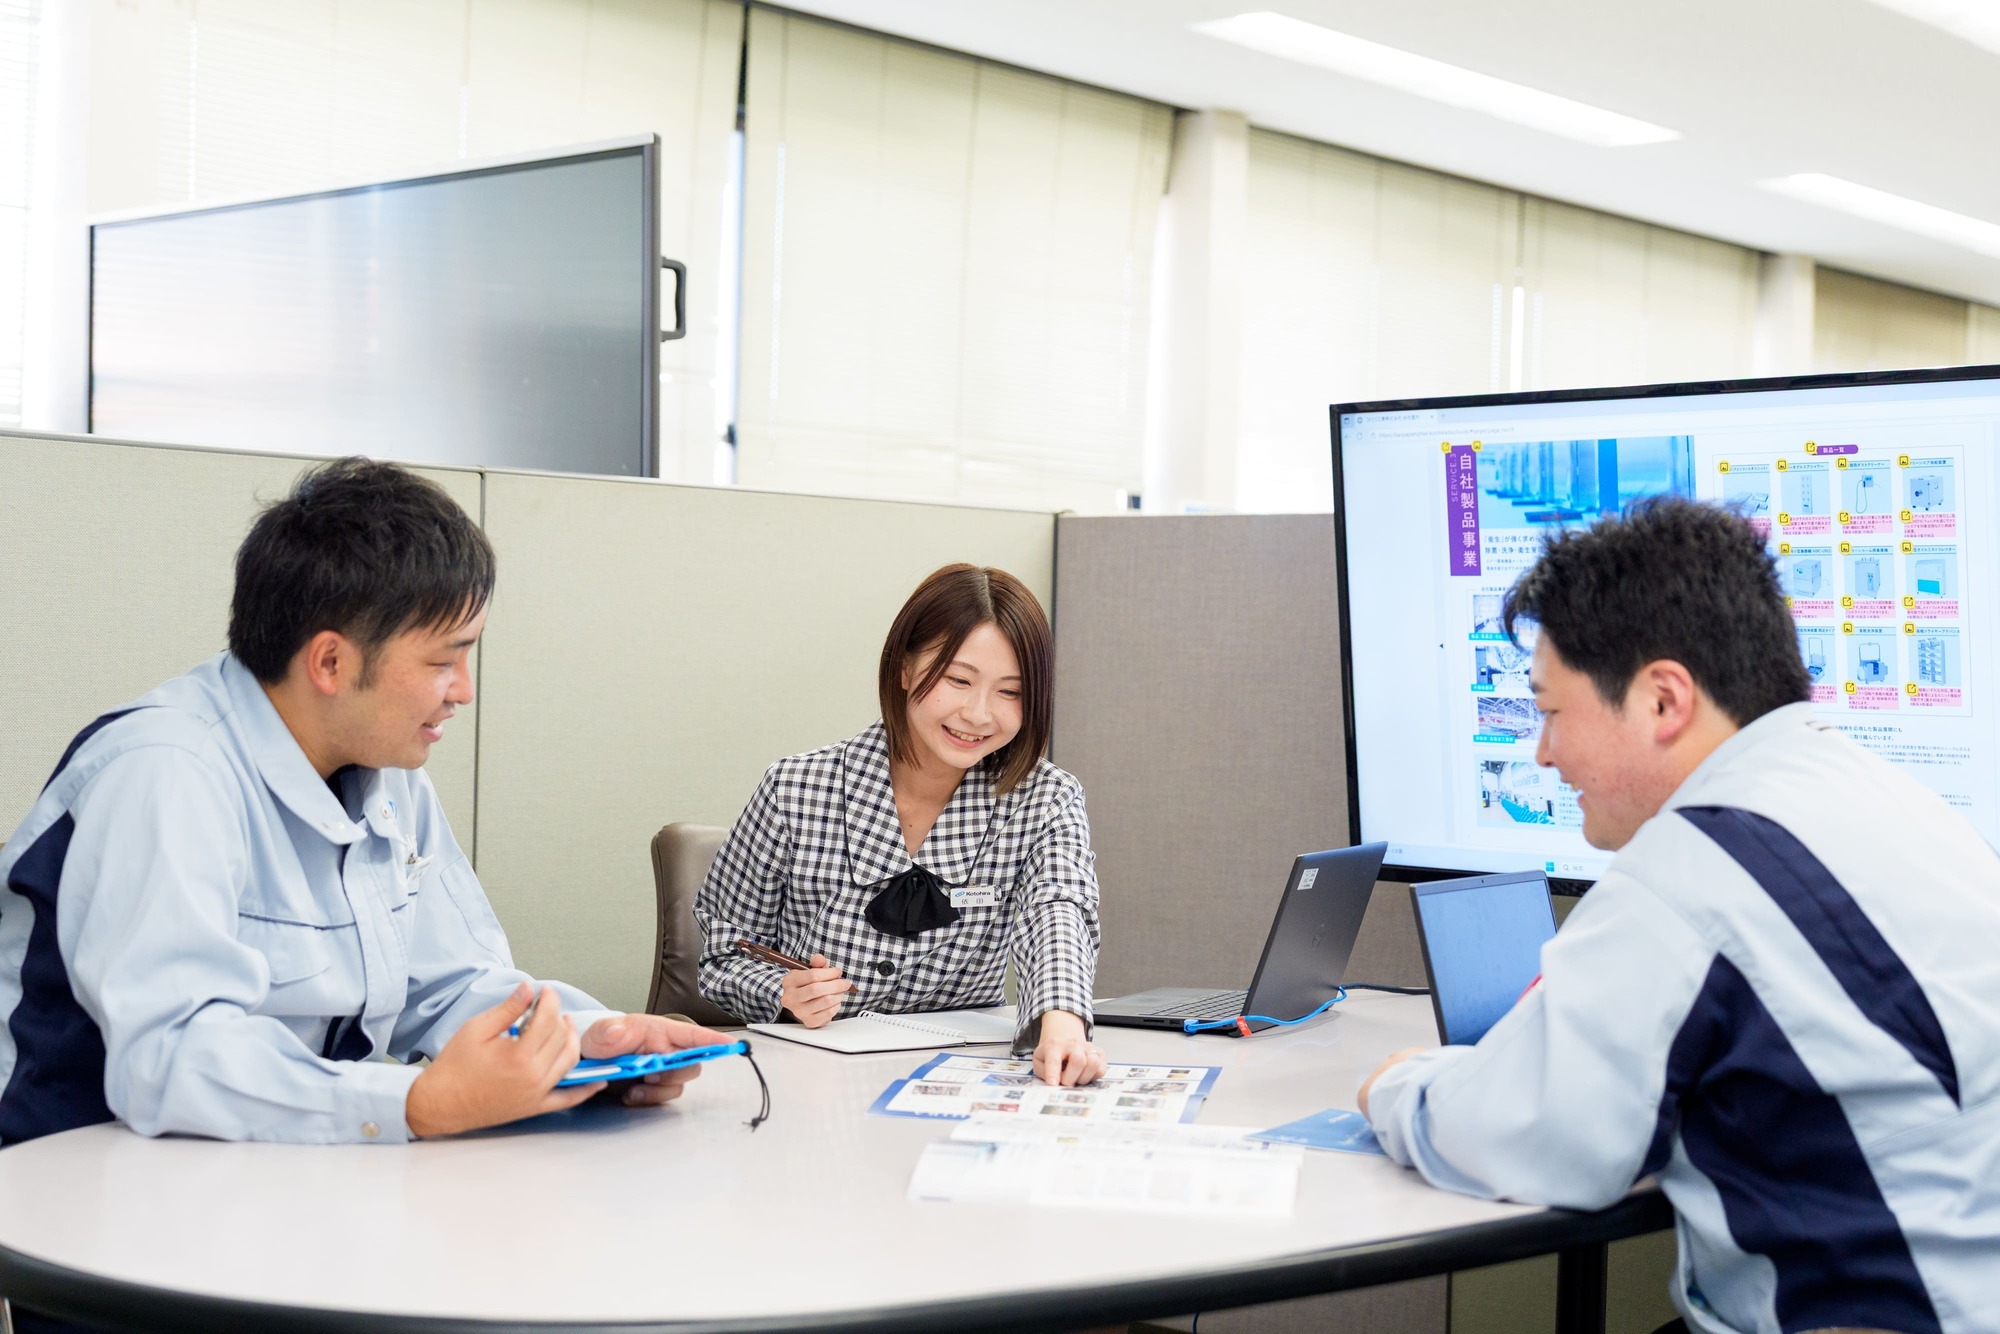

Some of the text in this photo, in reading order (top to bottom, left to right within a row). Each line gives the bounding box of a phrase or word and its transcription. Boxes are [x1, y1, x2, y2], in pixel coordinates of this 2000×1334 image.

[1449, 453, 1459, 503] SERVICE.3
[1460, 453, 1477, 567] 自社製品事業
